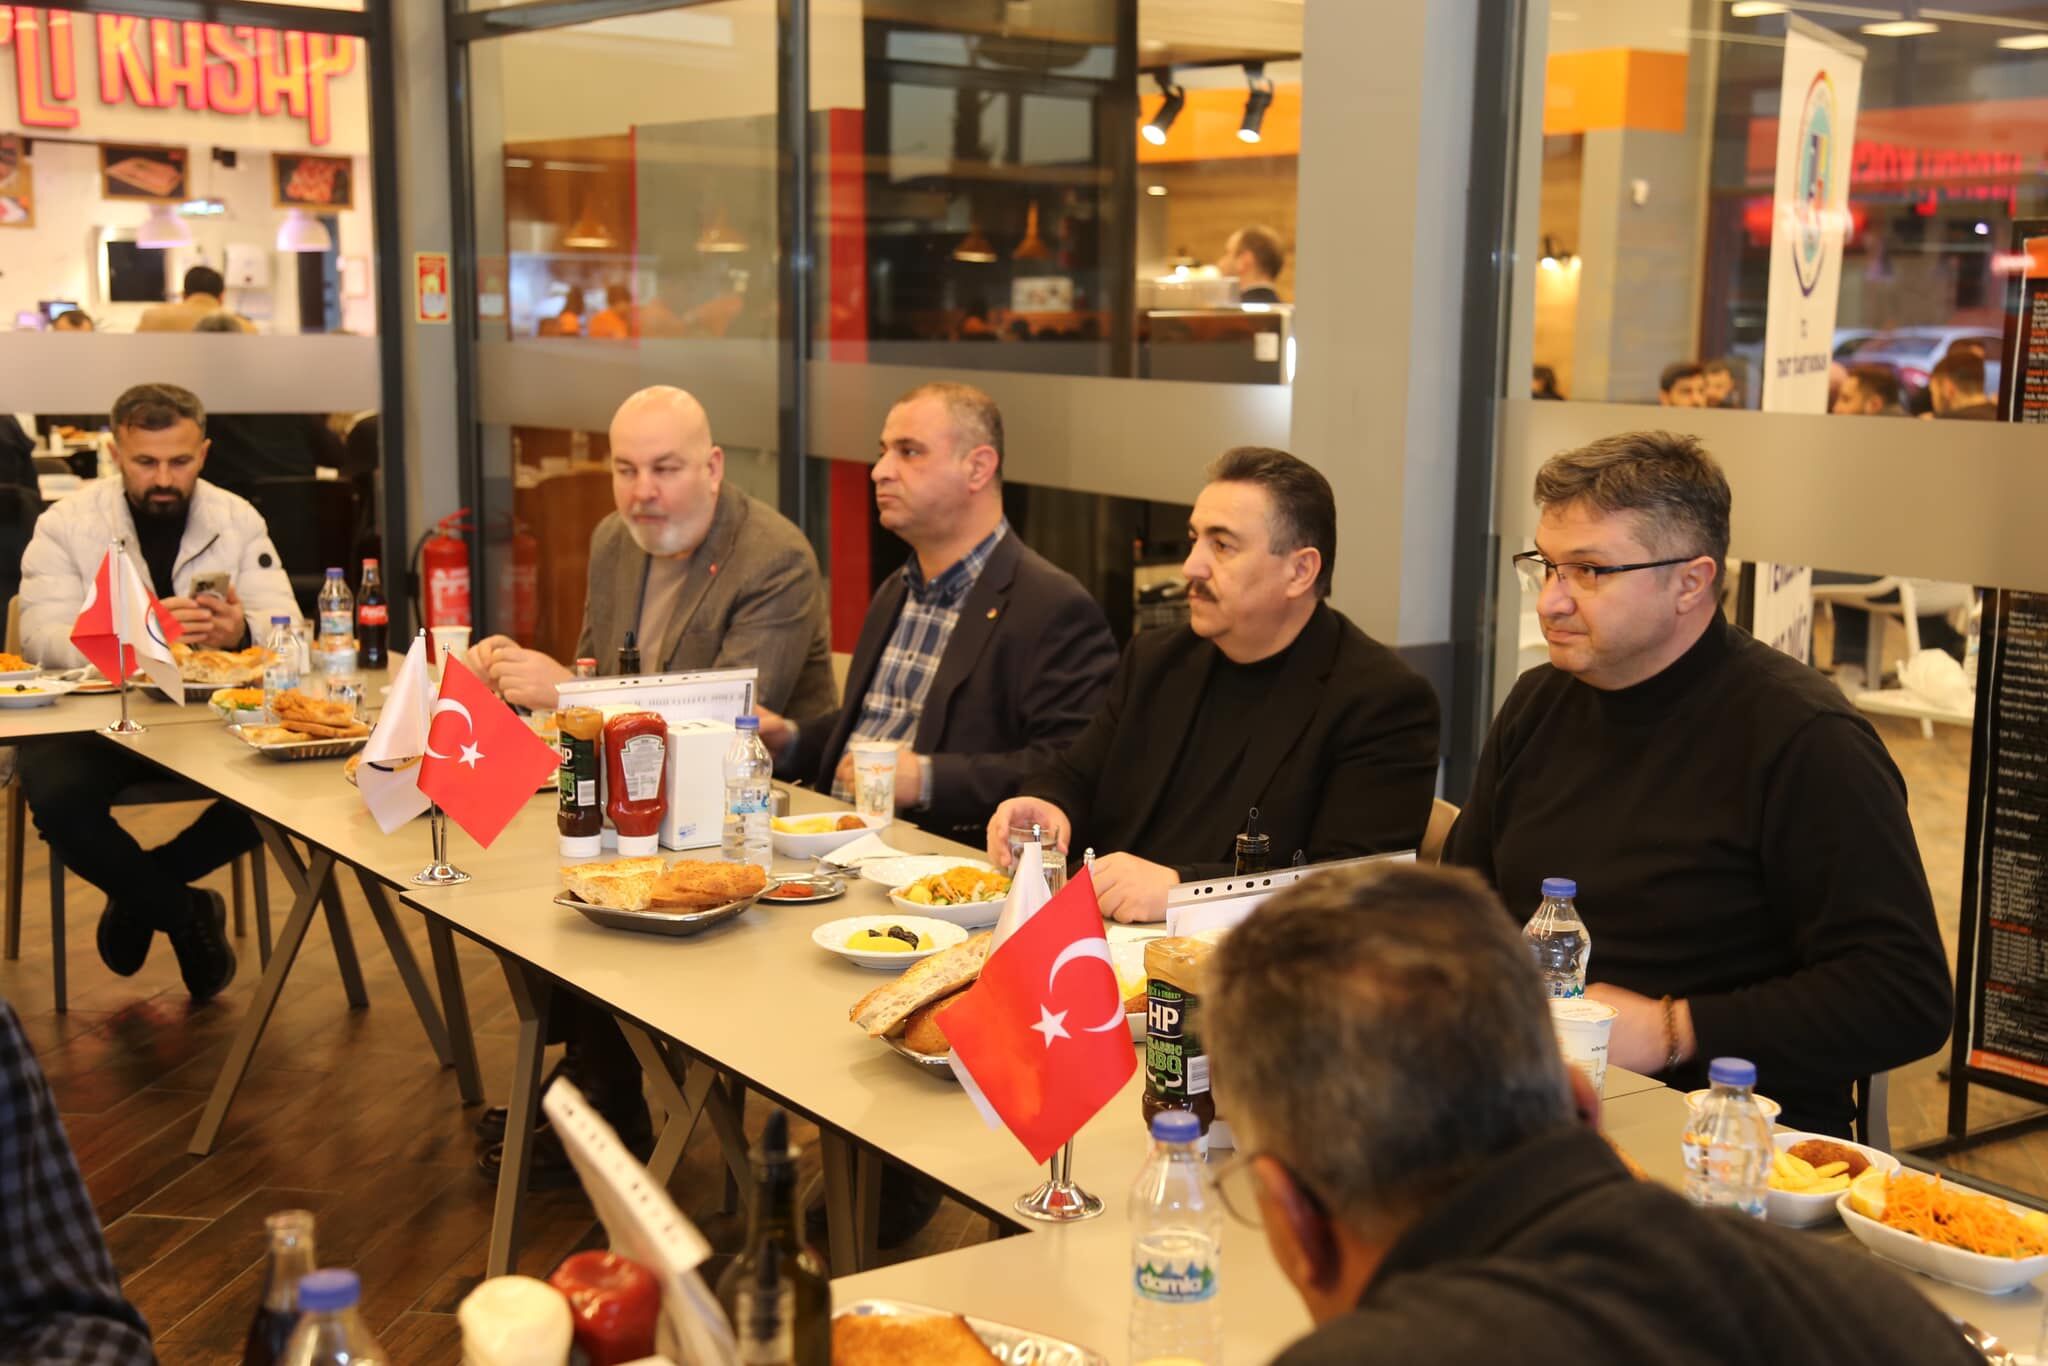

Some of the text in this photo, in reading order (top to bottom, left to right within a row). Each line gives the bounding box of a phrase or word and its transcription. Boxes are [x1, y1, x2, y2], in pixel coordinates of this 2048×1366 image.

[1148, 1000, 1179, 1032] HP
[1146, 1050, 1183, 1076] BBQ
[1140, 1270, 1203, 1295] damla
